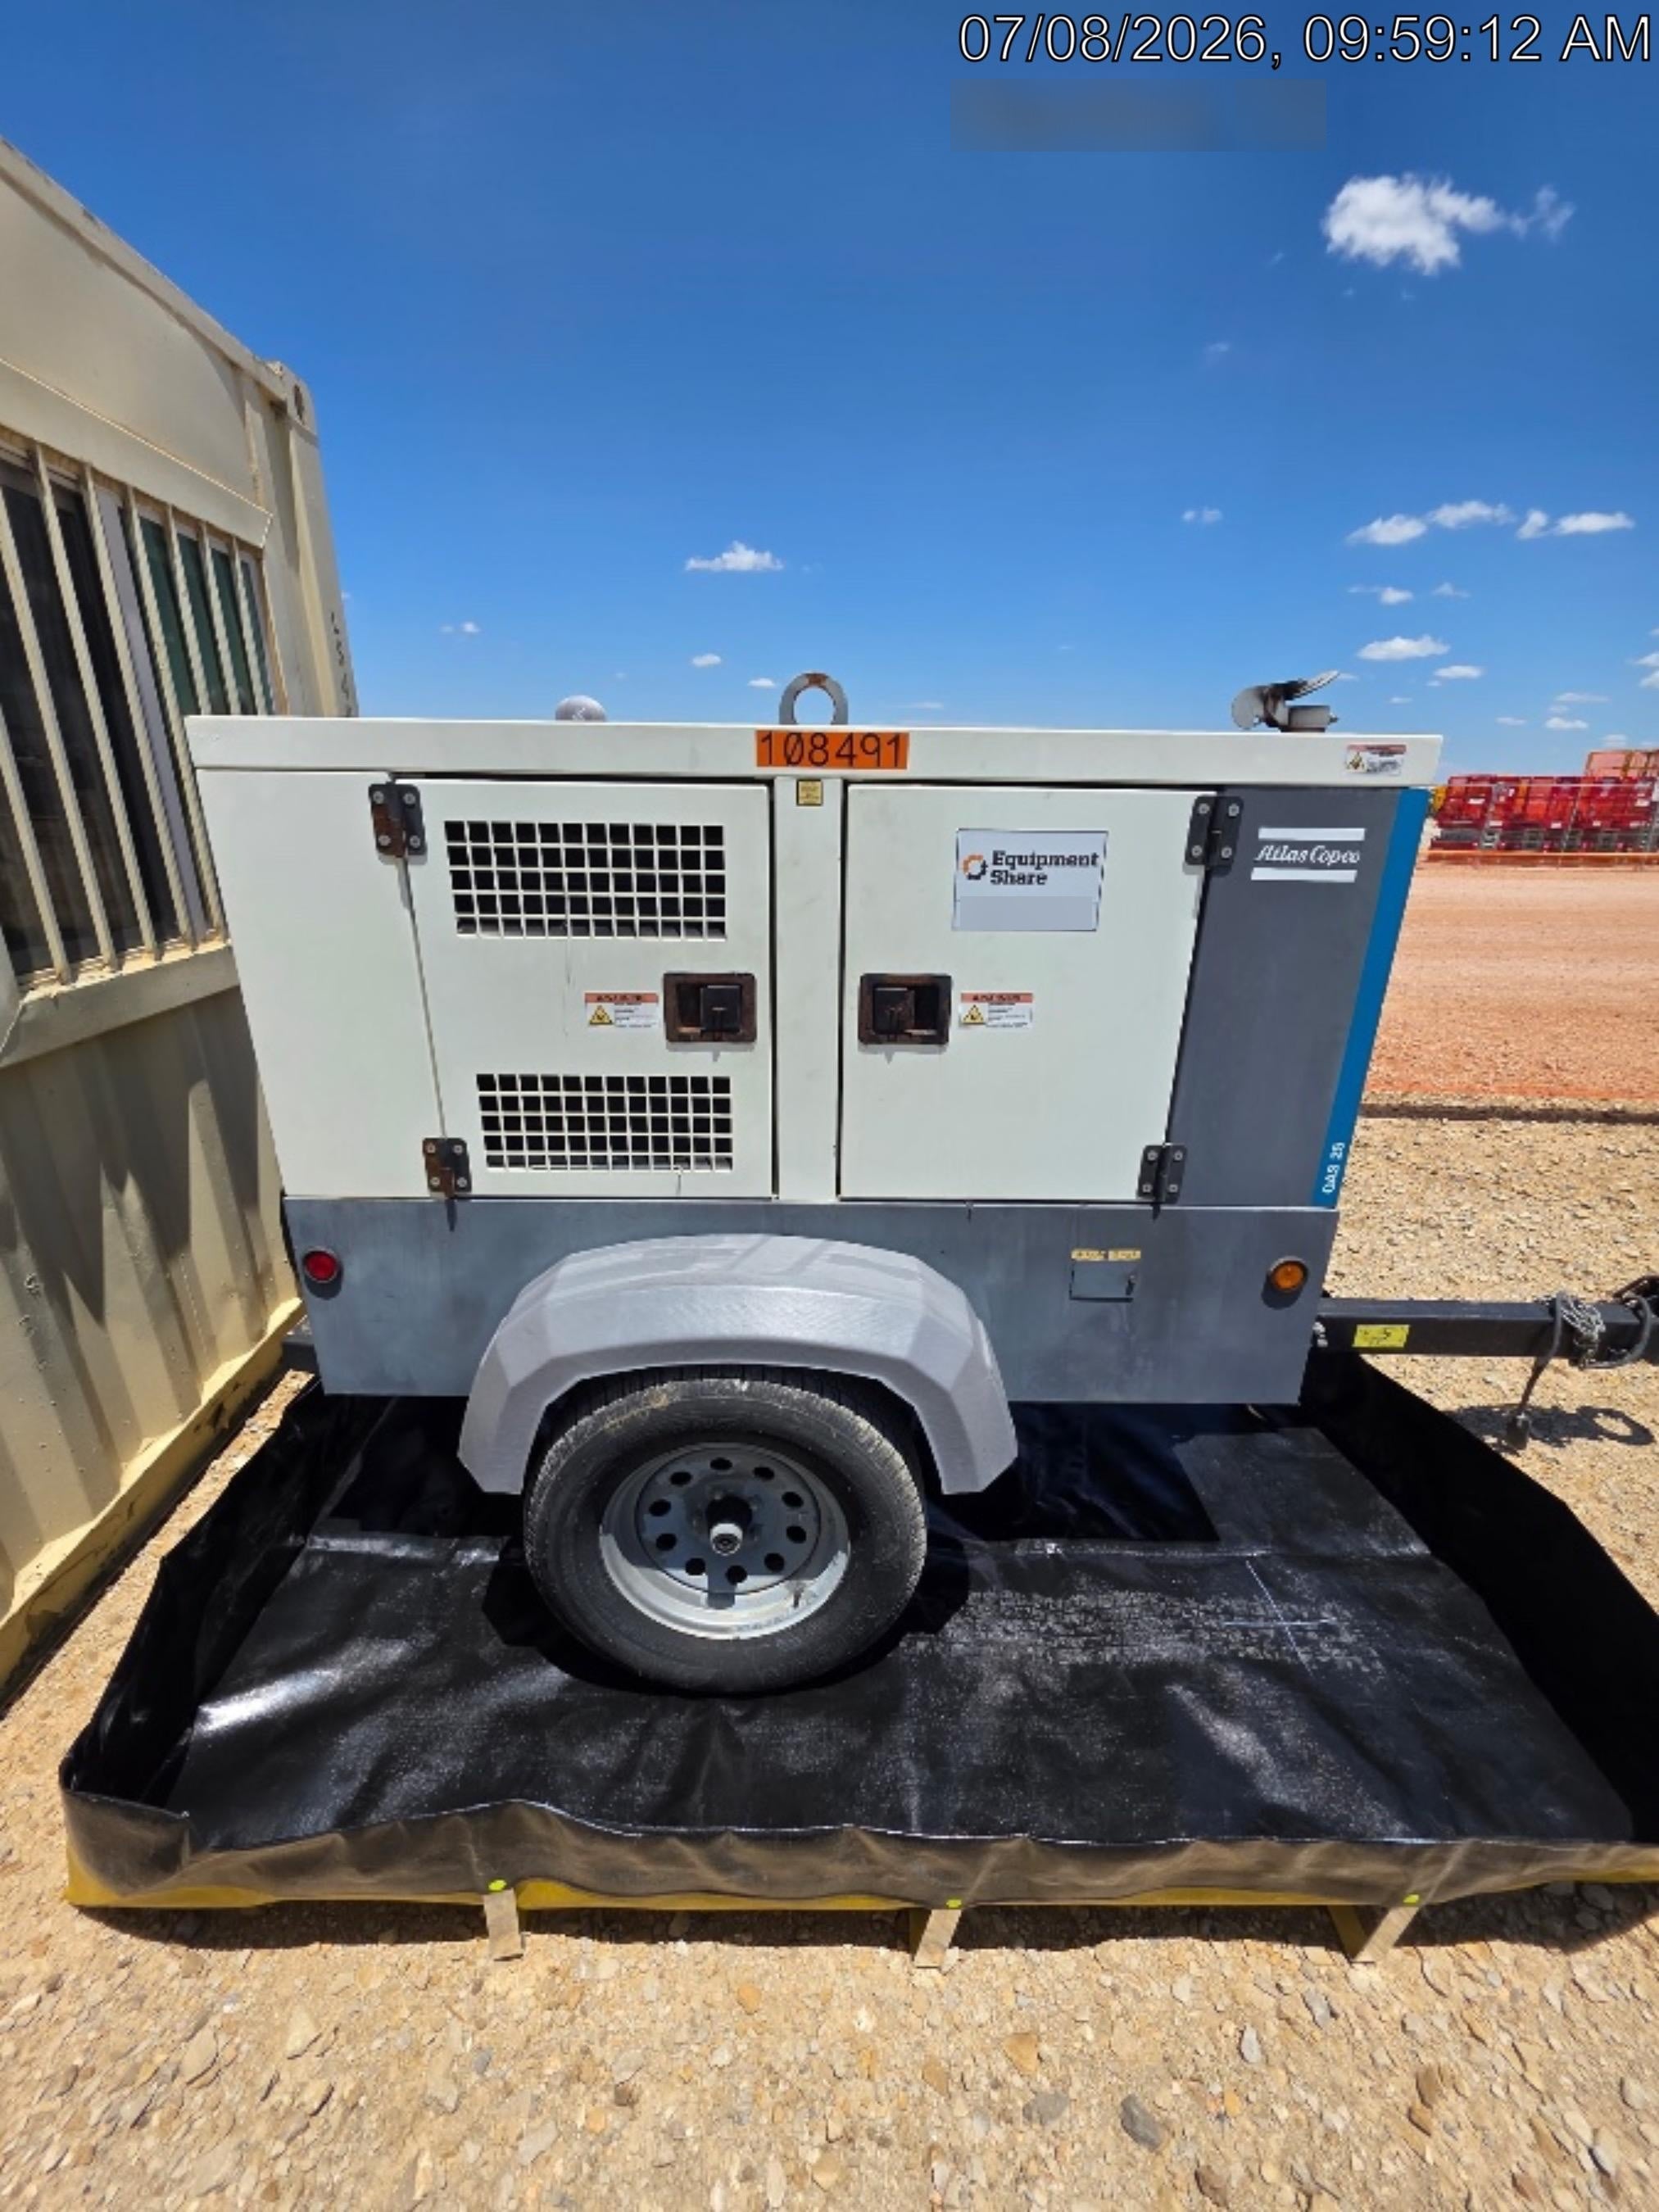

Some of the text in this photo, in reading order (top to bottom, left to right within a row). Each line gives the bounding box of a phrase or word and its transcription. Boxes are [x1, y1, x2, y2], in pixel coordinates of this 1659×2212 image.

[761, 732, 900, 767] 108491
[992, 850, 1099, 870] Equipment
[1254, 845, 1361, 867] Atlas Copco
[990, 870, 1048, 885] Share
[1321, 1164, 1340, 1194] QAS
